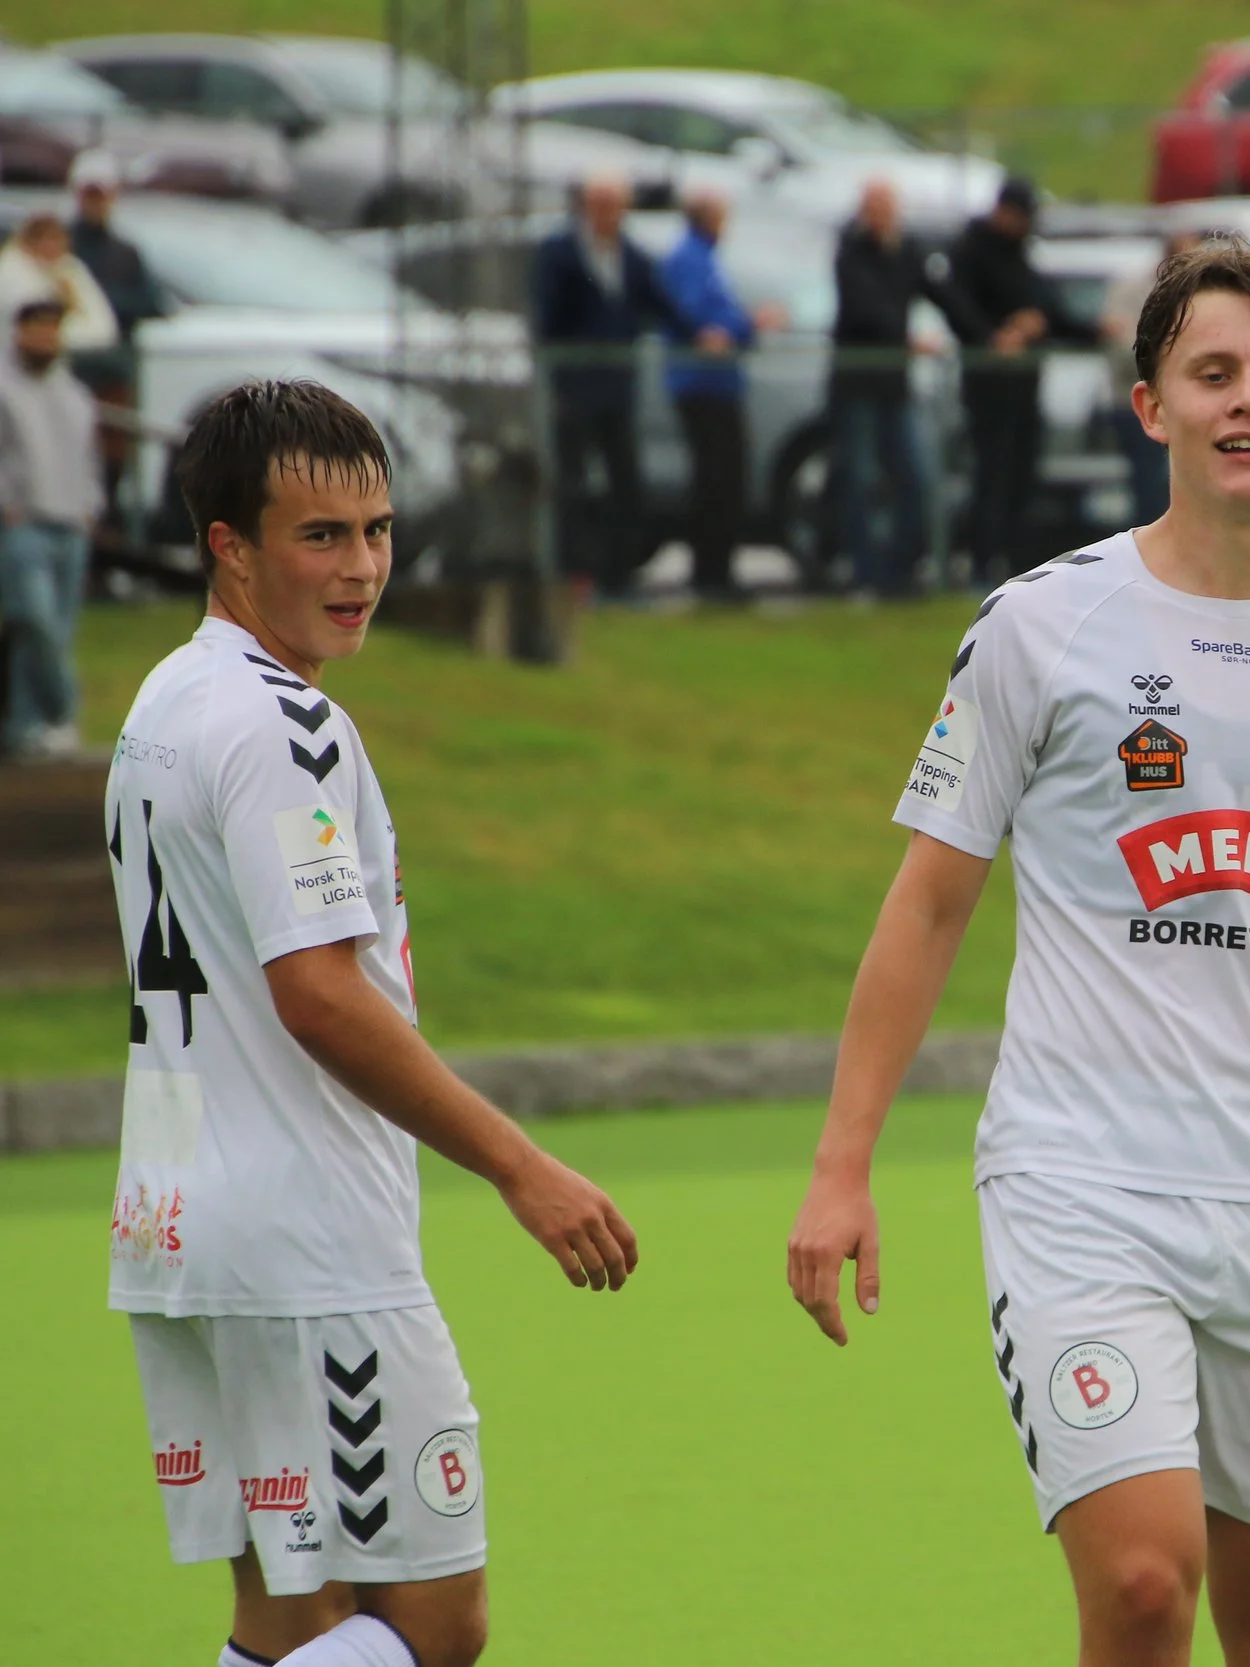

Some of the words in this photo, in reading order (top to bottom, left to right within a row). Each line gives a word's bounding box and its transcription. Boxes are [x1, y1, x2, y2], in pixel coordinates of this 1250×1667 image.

[1128, 703, 1180, 716] hummel
[1132, 752, 1175, 764] KLUBB
[914, 757, 962, 788] Tipping-
[1139, 766, 1168, 778] HUS
[294, 870, 335, 890] Norsk
[322, 886, 364, 905] LIGAE
[1072, 1364, 1110, 1409] B
[153, 1439, 205, 1486] nini
[439, 1451, 466, 1497] B
[286, 1540, 322, 1552] hummel
